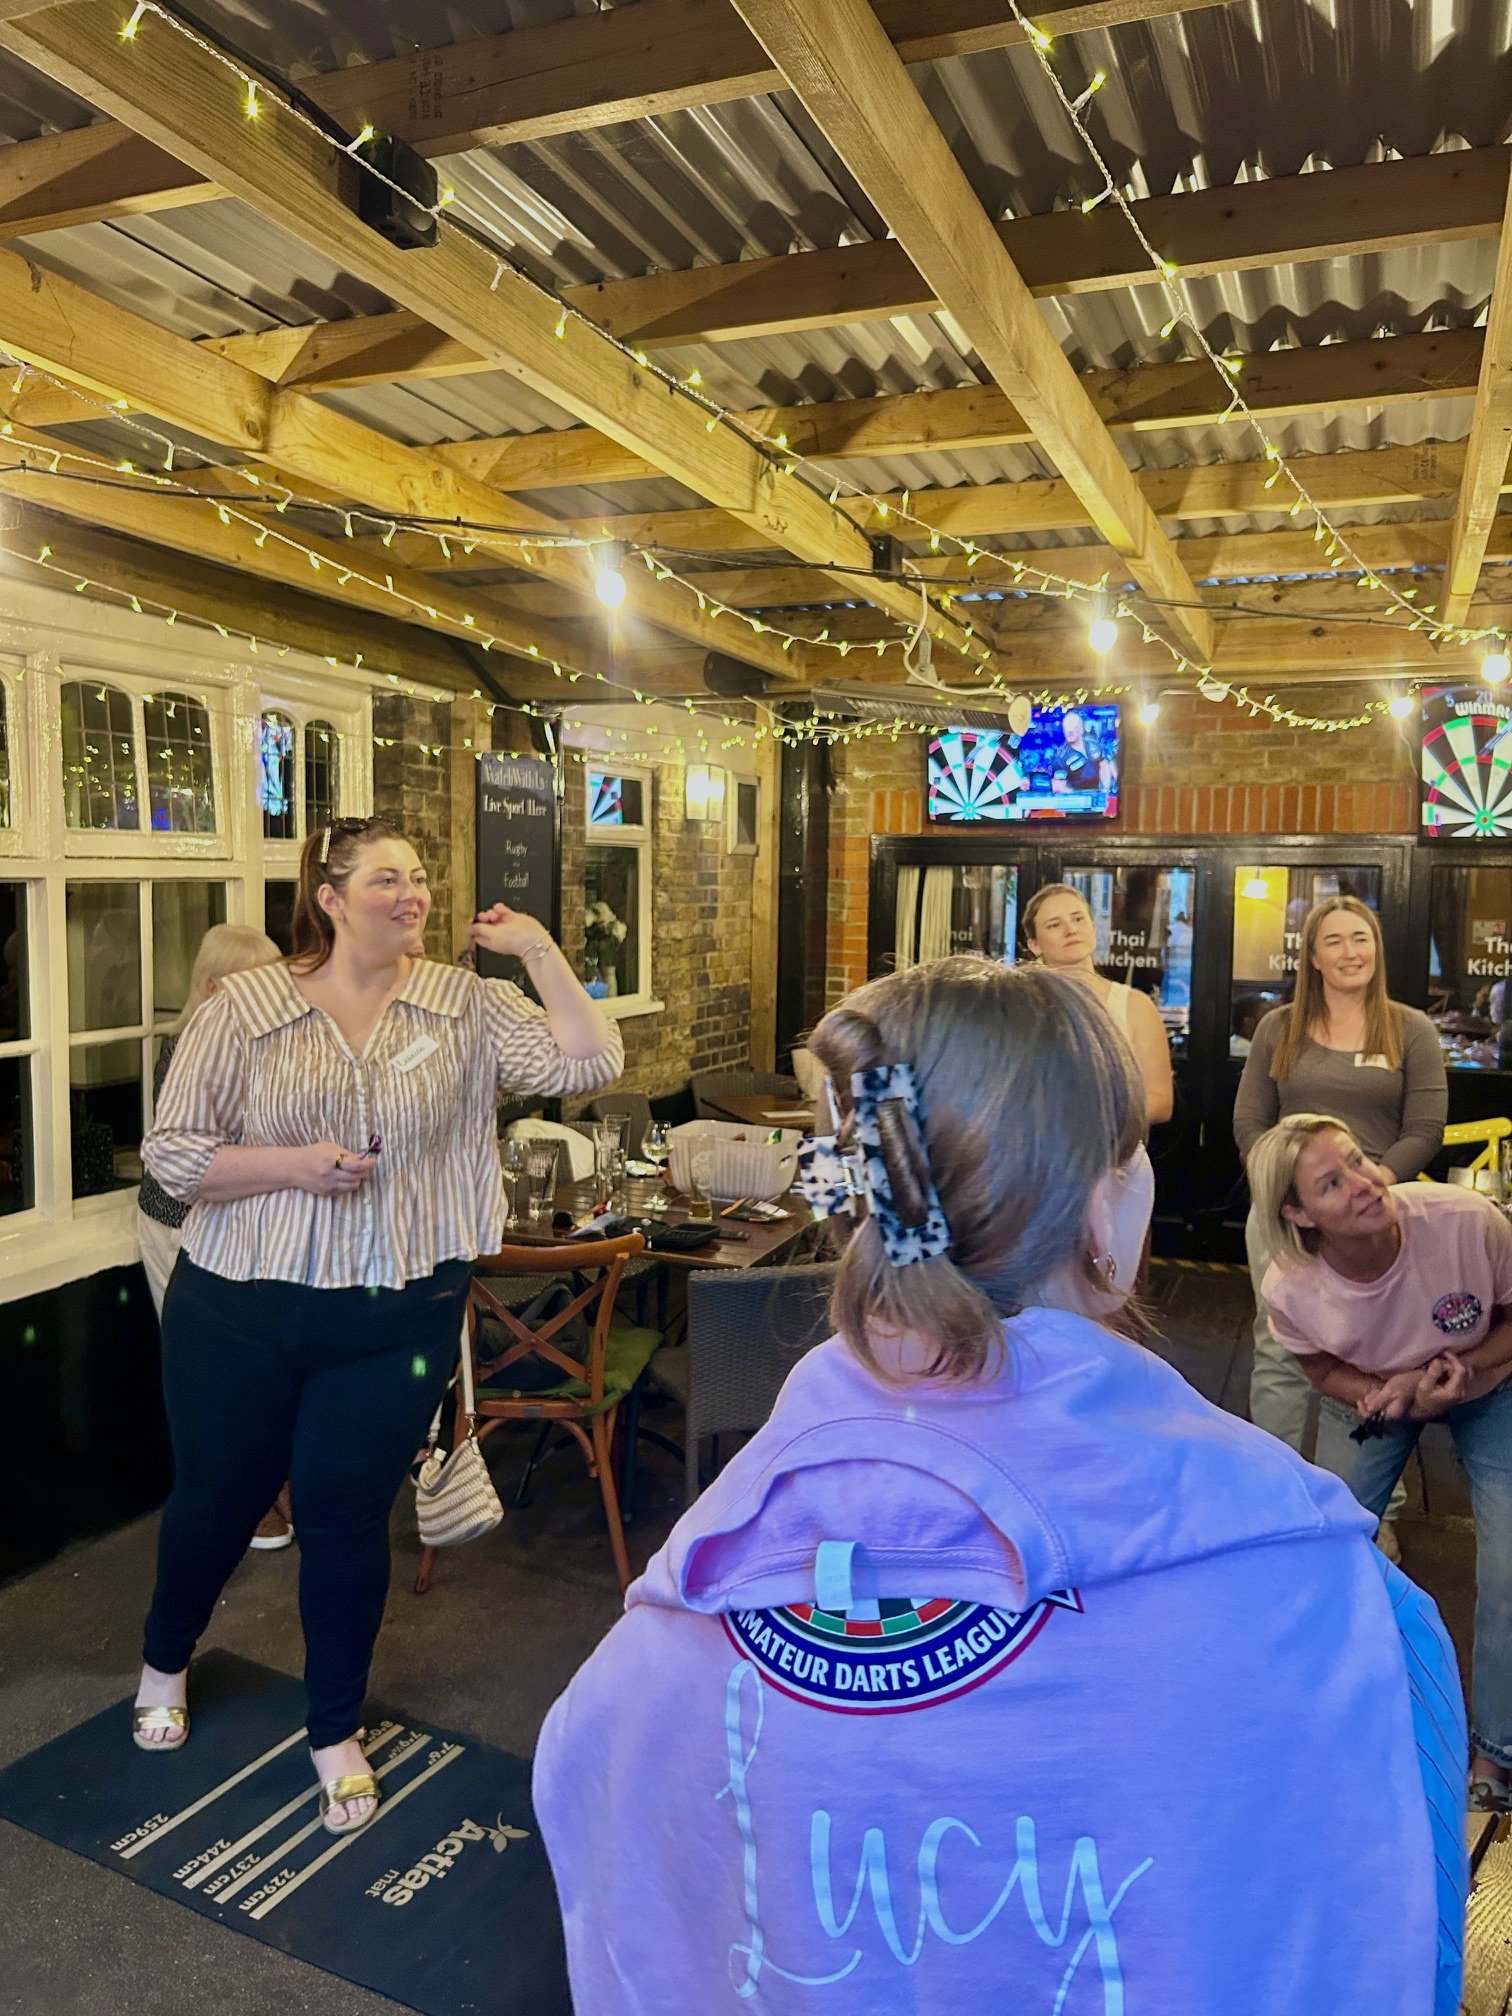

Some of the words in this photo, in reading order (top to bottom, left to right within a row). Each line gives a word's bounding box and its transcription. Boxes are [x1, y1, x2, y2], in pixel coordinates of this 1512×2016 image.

[506, 840, 528, 857] Rugby
[504, 872, 529, 888] Football
[1108, 930, 1145, 947] Thai
[1484, 936, 1512, 954] Th
[1269, 953, 1301, 971] Kitc
[835, 1659, 920, 1692] DARTS
[110, 1813, 169, 1851] 259cm
[715, 1661, 1154, 2016] Lucy
[172, 1838, 231, 1879] 244cm
[203, 1853, 261, 1894] 237cm
[382, 1818, 486, 1907] Actias
[238, 1868, 296, 1910] 229cm
[365, 1869, 400, 1898] mat
